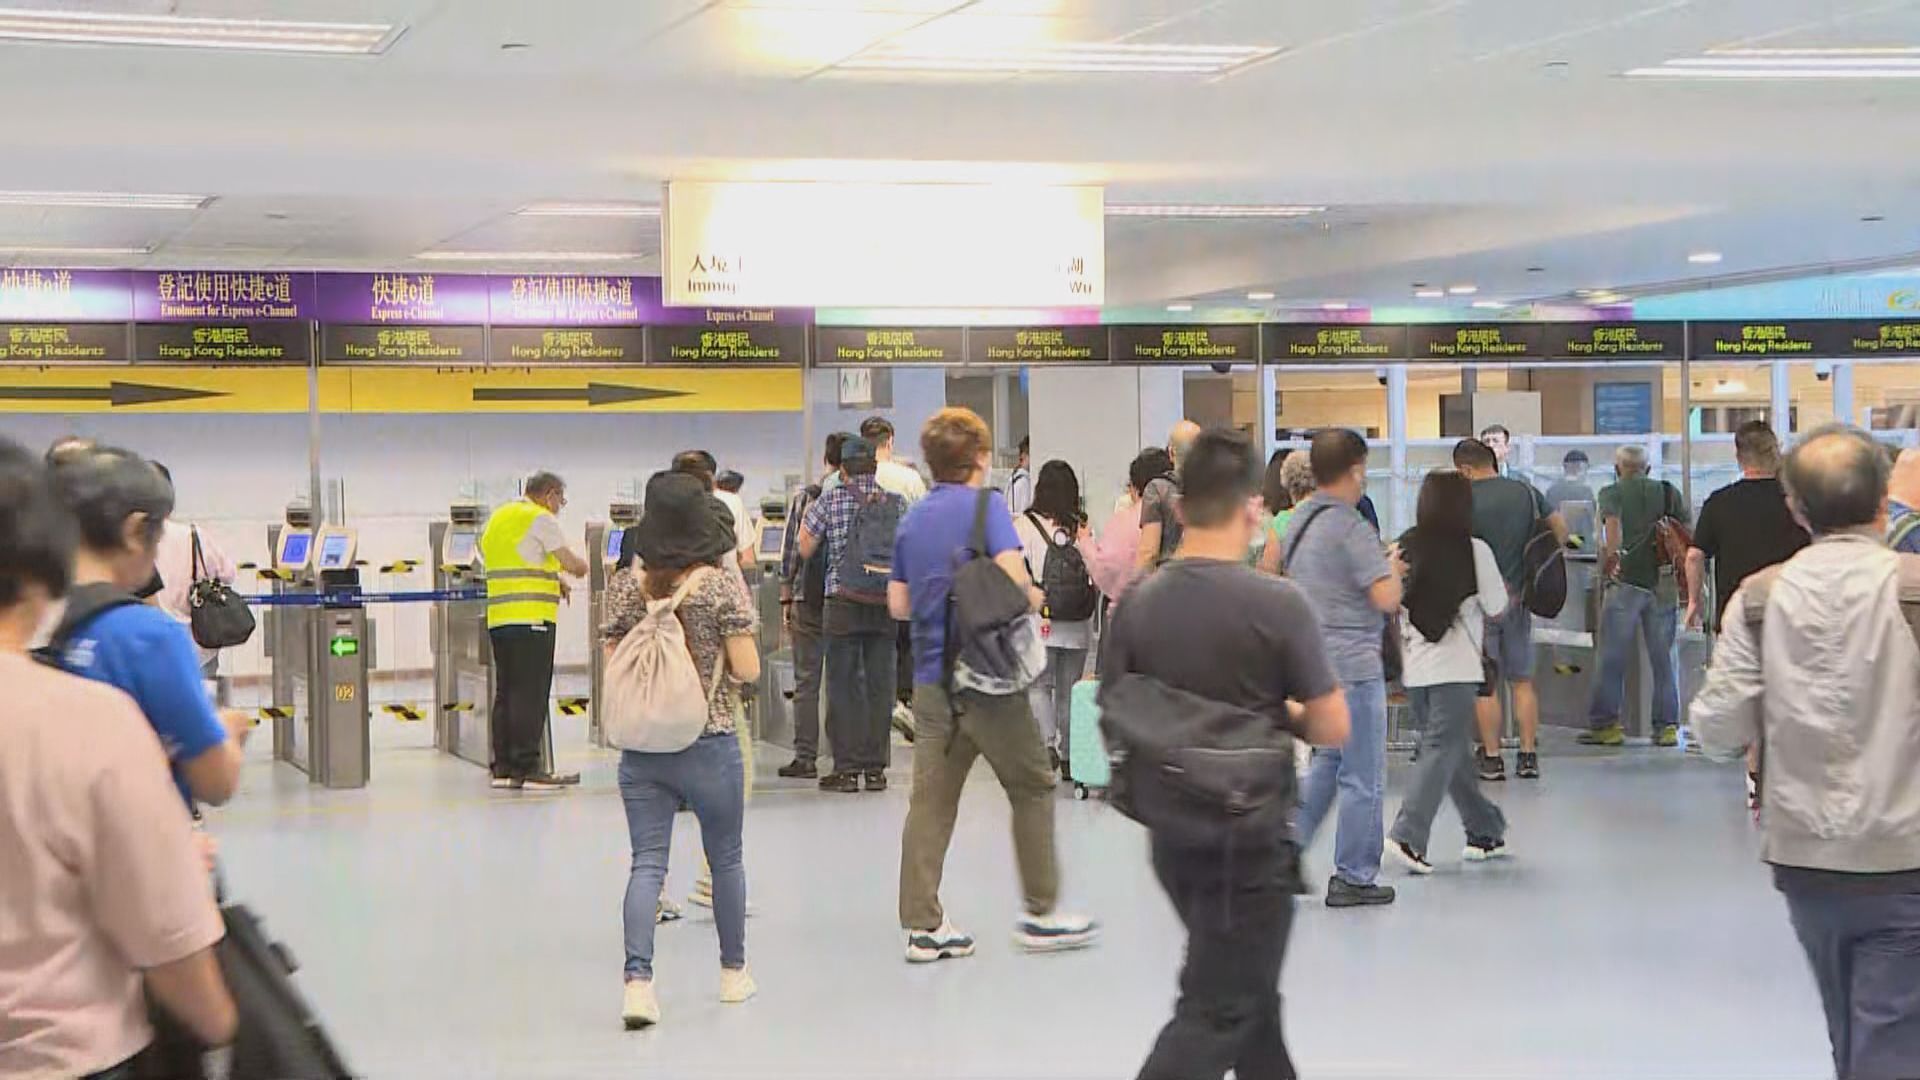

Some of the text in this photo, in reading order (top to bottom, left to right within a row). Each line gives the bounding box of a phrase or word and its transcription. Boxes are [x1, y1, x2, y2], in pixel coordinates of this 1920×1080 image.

[159, 272, 292, 303] 登記使用快捷e道
[372, 273, 434, 305] 快捷e道
[512, 276, 633, 305] 登記使用快捷e道
[161, 304, 297, 319] Enrolment for Express e-Channel
[371, 306, 403, 321] Express
[706, 309, 774, 323] Express e-Channel
[9, 328, 68, 343] 香港居民
[193, 328, 249, 343] 香港居民
[378, 330, 430, 345] 香港居民
[543, 331, 594, 346] 香港居民
[701, 332, 750, 346] 香港居民
[867, 331, 914, 345] 香港居民
[1016, 331, 1064, 345] 香港居民
[1162, 331, 1208, 345] 香港居民
[1317, 330, 1361, 343] 香港居民
[1457, 329, 1500, 342] 香港居民
[1593, 328, 1637, 341] 香港居民
[1742, 326, 1786, 339] 香港居民
[10, 345, 41, 357] Kong
[45, 344, 105, 356] Residents
[160, 344, 283, 358] Hong Kong Residents
[346, 344, 462, 358] Hong Kong Residents
[512, 344, 624, 358] Hong Kong Residents
[1135, 344, 1236, 357] Hong Kong Residents
[1290, 343, 1389, 355] Hong Kong Residents
[1430, 342, 1527, 354] Hong Kong Residents
[1567, 341, 1664, 353] Hong Kong Residents
[1716, 340, 1812, 352] Hong Kong Residents
[1854, 339, 1878, 349] Hong
[1880, 339, 1904, 349] Kong
[671, 345, 779, 358] Hong Kong Residents
[838, 346, 943, 358] Hong Kong Residents
[988, 346, 1091, 358] Hong Kong Residents
